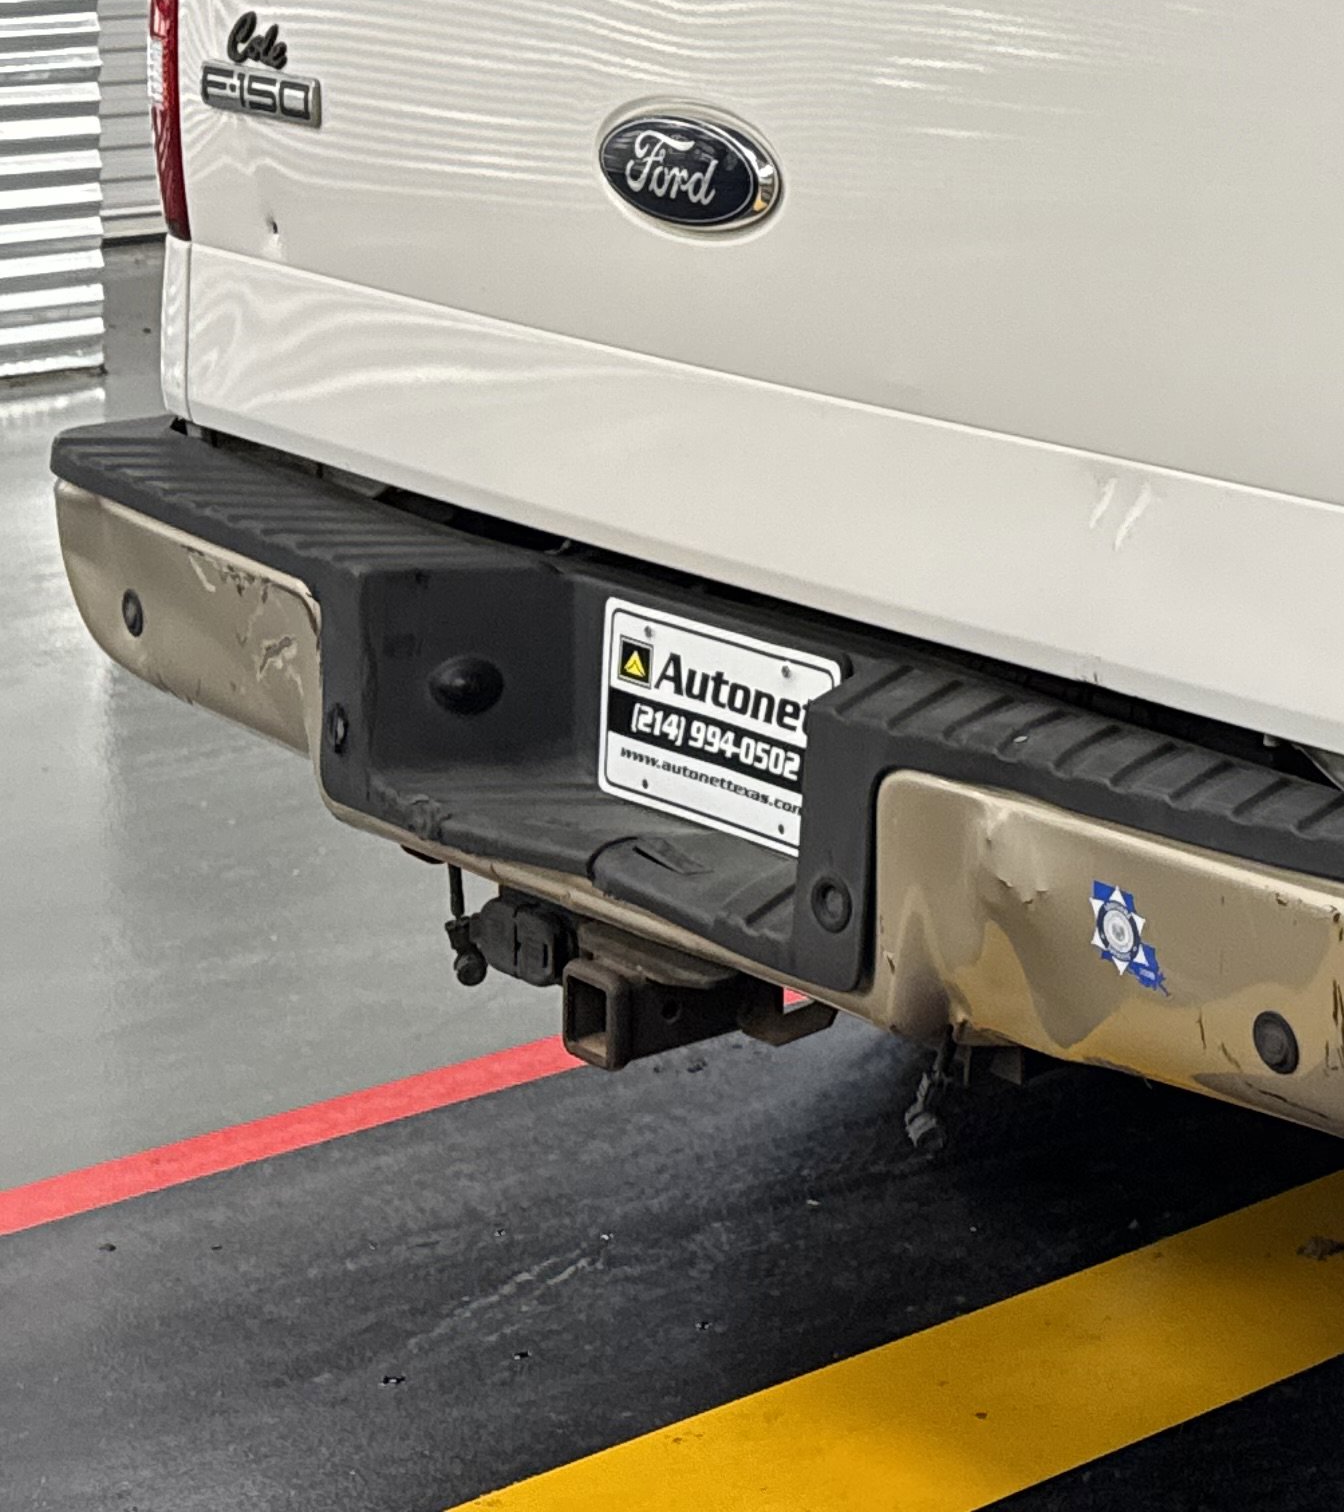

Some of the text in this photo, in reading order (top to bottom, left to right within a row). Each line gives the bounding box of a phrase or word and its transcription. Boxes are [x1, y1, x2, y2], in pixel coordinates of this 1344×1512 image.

[625, 130, 718, 206] Ford
[630, 702, 800, 782] (214) 994-0502
